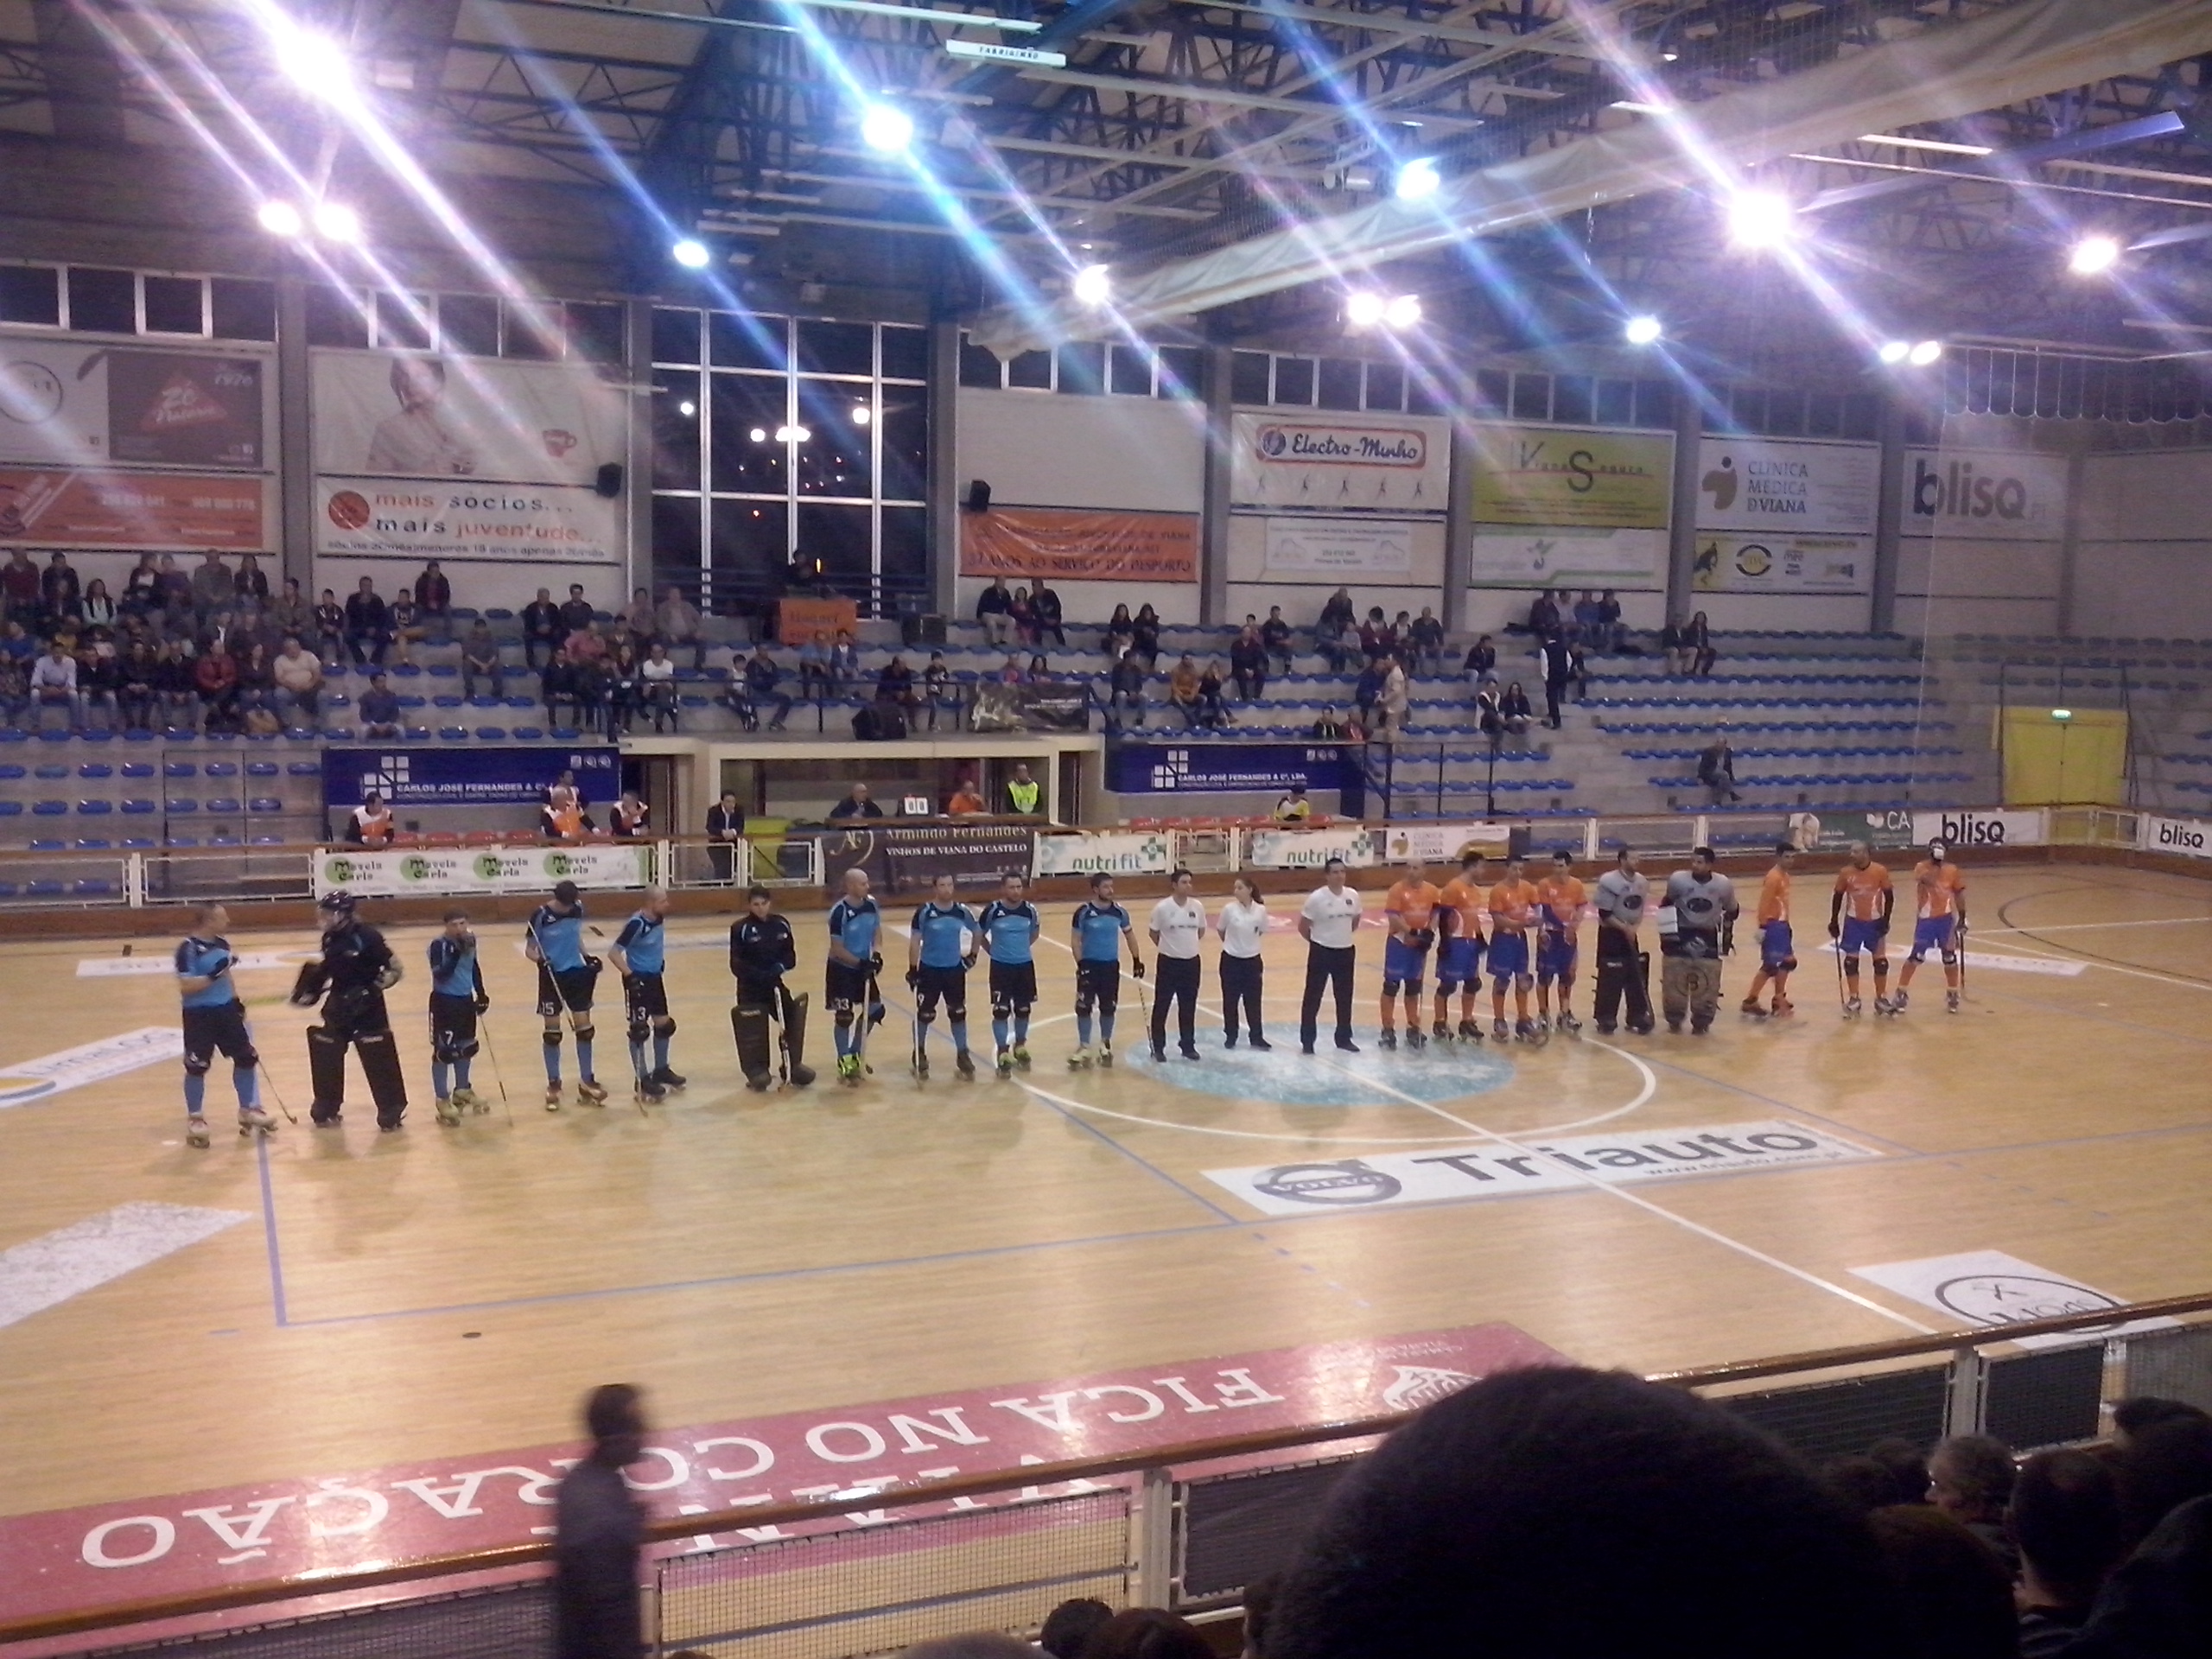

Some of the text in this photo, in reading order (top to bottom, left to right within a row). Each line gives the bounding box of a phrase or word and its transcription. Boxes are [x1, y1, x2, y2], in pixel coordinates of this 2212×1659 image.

[1292, 433, 1418, 460] Electro-Minho
[375, 493, 435, 508] mais
[376, 518, 446, 534] mais
[1887, 810, 1911, 830] CA
[953, 825, 1027, 839] Fernandes
[886, 843, 1027, 856] VINHOS DE VIANA DO CASTELO
[542, 1001, 555, 1015] 15
[835, 997, 849, 1010] 33
[1410, 1133, 1818, 1182] Triauto
[1272, 1175, 1383, 1192] VOLVO
[991, 1368, 1285, 1435] FICA
[805, 1407, 990, 1464] NO
